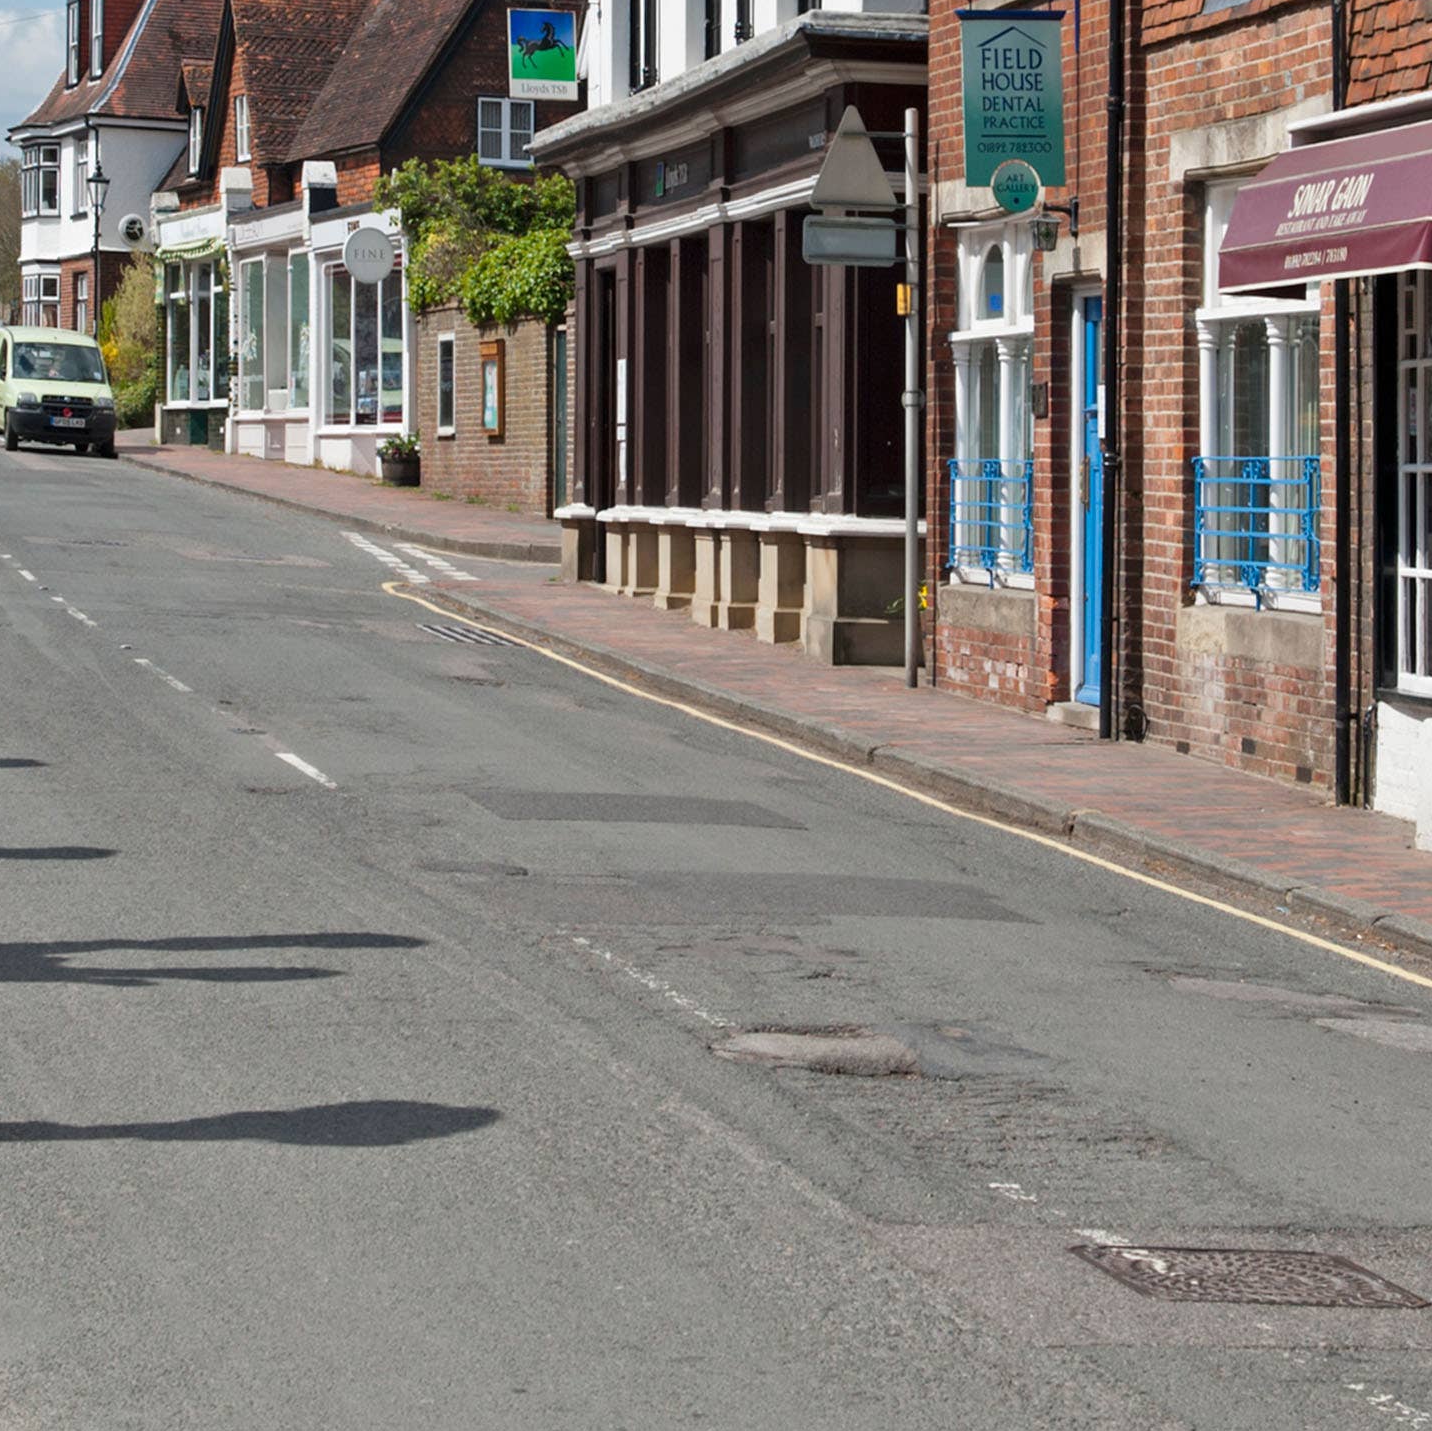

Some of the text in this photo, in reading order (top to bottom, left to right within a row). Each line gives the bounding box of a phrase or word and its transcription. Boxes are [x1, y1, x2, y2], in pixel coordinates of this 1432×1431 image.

[981, 48, 1043, 70] FIELD
[981, 72, 1044, 92] HOUSE
[521, 83, 568, 95] Lloyds TSB
[982, 96, 1045, 112] DENTAL
[983, 116, 1045, 129] PRACTICE
[977, 142, 1052, 153] 01892 782300
[1005, 174, 1024, 182] ART
[996, 183, 1036, 193] GALLERY
[1287, 173, 1374, 218] SONAR GAON
[354, 248, 386, 259] FINE
